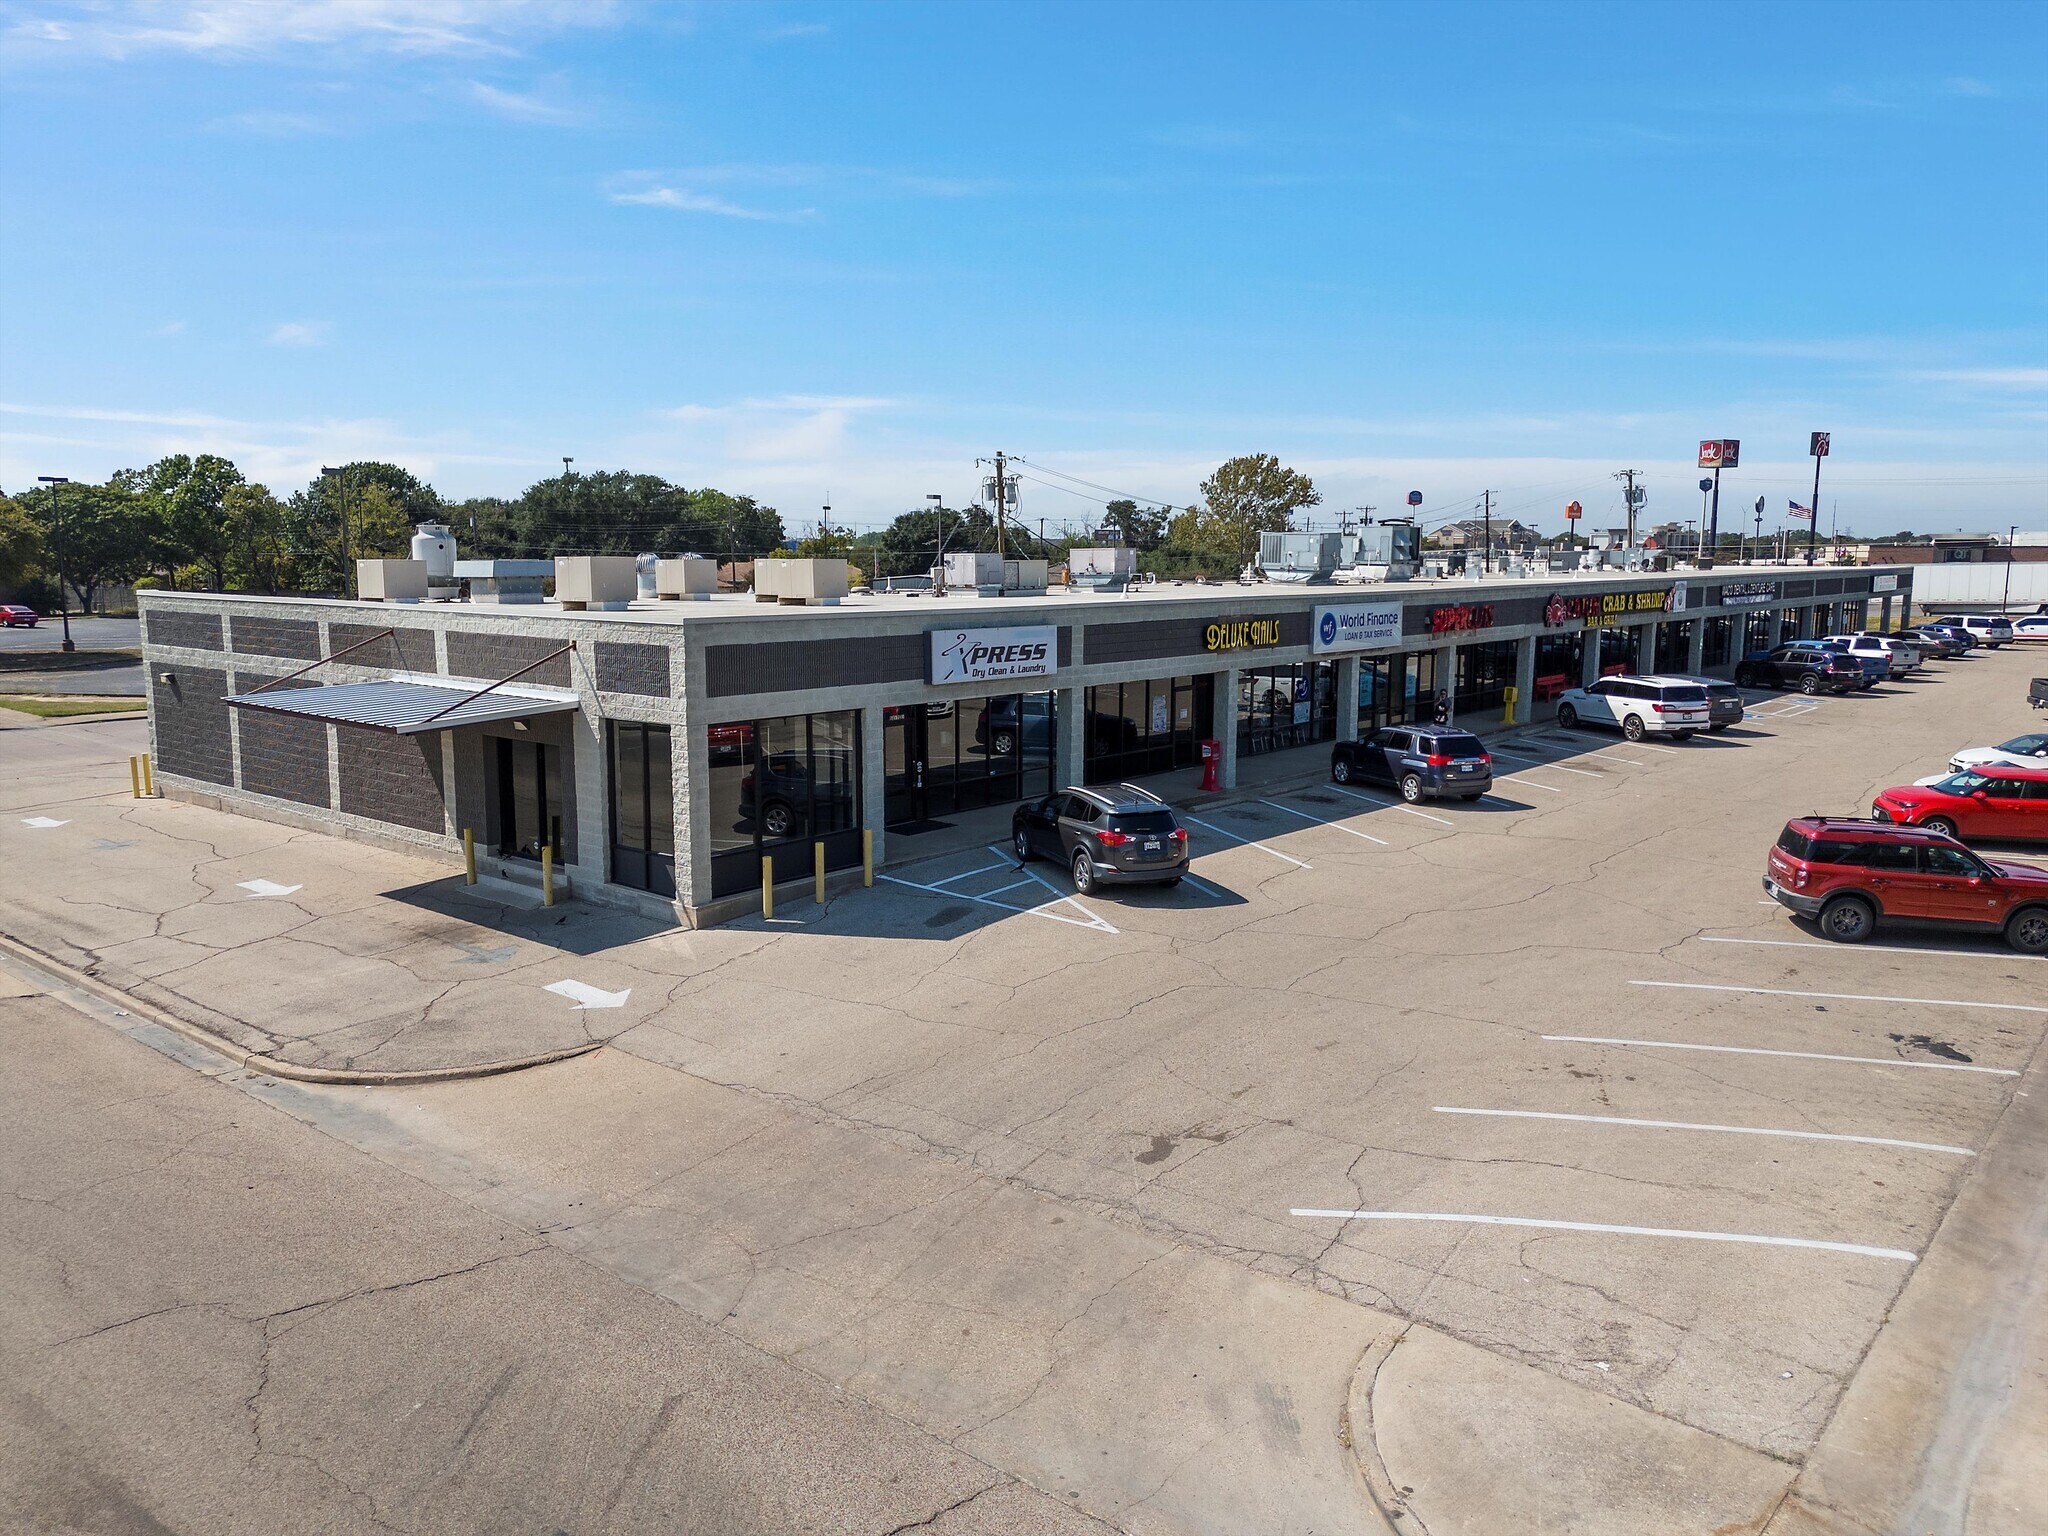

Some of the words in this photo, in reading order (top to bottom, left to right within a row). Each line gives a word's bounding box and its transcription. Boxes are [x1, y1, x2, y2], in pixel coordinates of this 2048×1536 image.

[1700, 443, 1721, 460] Jack
[1602, 595, 1626, 613] CRAB
[1628, 595, 1633, 610] &
[1636, 592, 1666, 610] SHRIMP
[1340, 612, 1364, 628] World
[1367, 612, 1399, 626] Finance
[1587, 615, 1598, 627] BAR
[1207, 622, 1249, 650] DELUXE
[1251, 619, 1280, 646] NAILS
[1345, 631, 1358, 640] LOAN
[1364, 630, 1373, 639] TAX
[1374, 629, 1393, 638] SERVICE
[972, 668, 985, 679] Dry
[988, 666, 1007, 676] Clean
[1010, 665, 1015, 674] &
[1018, 664, 1046, 674] Laundry
